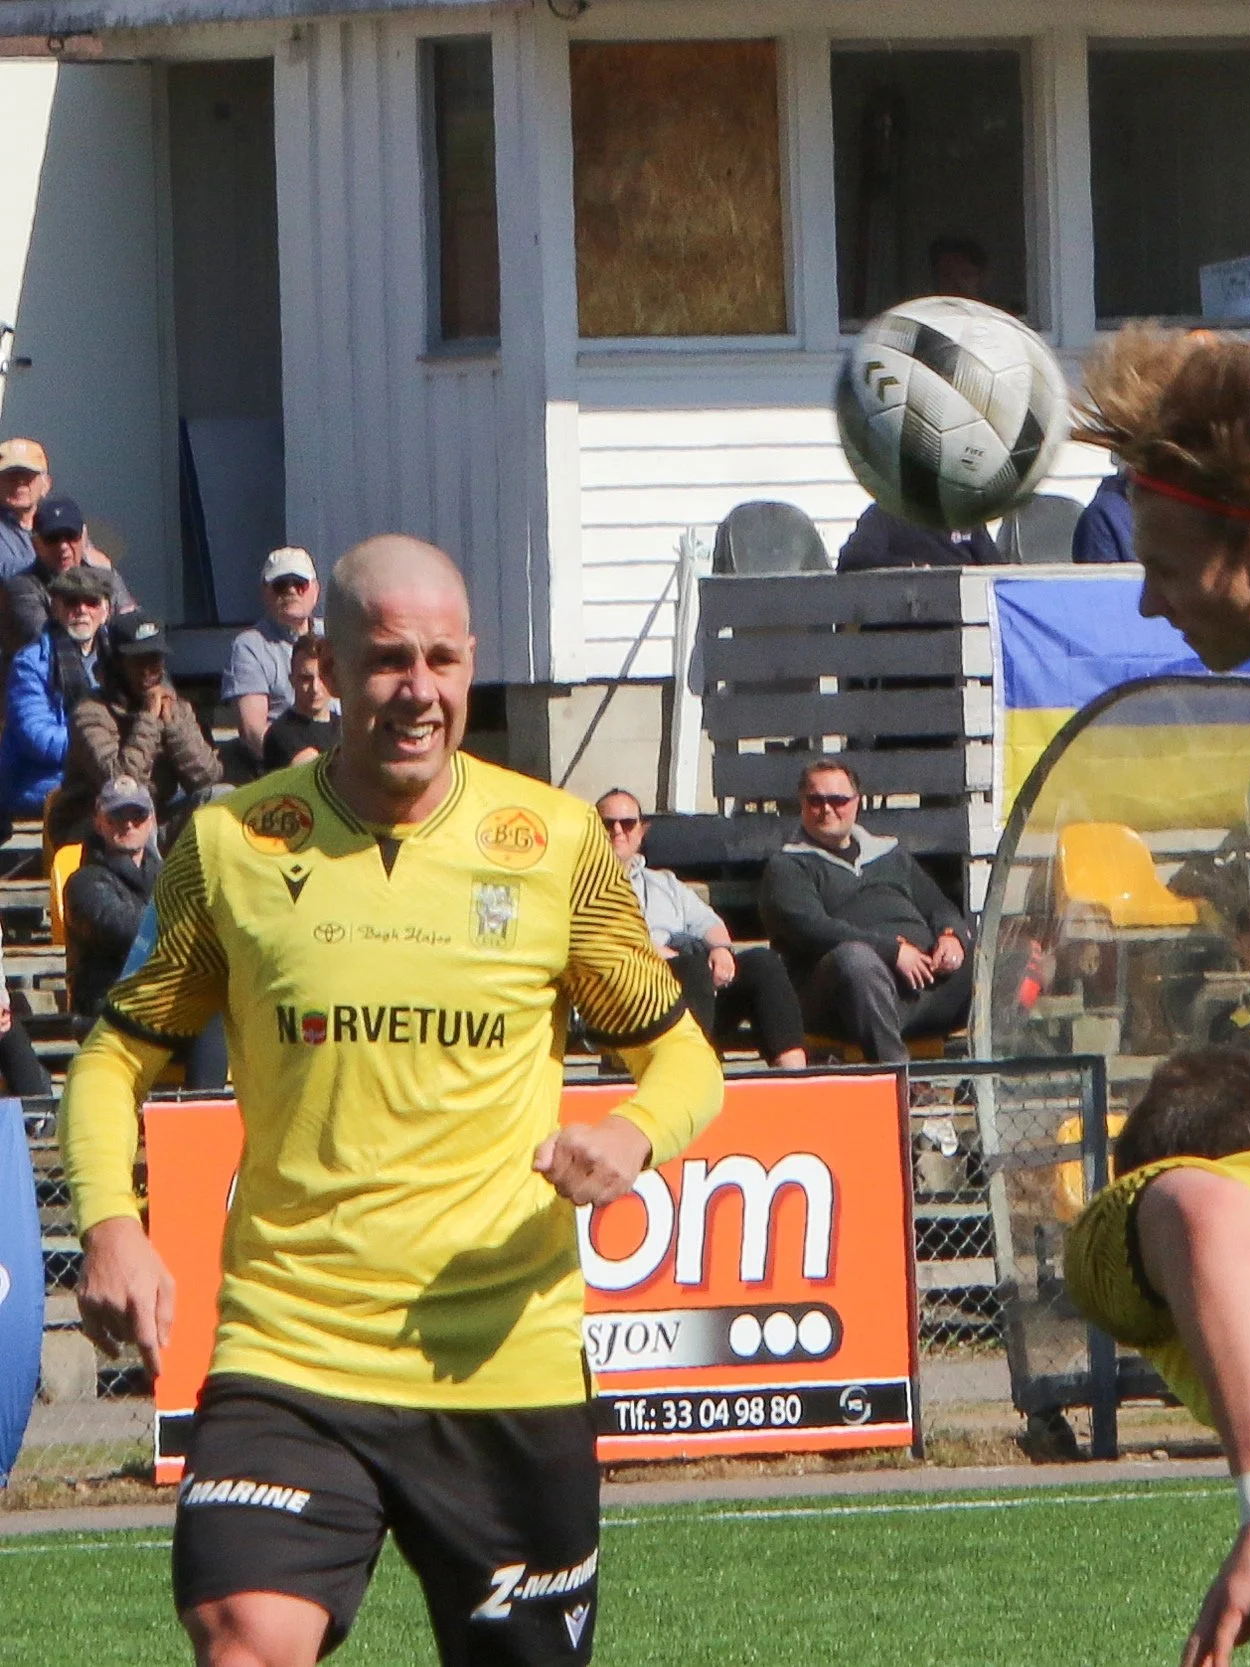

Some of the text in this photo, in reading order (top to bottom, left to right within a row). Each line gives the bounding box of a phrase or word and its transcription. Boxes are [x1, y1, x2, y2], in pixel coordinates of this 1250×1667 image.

[613, 1392, 803, 1431] Tlf.: 33 04 98 80
